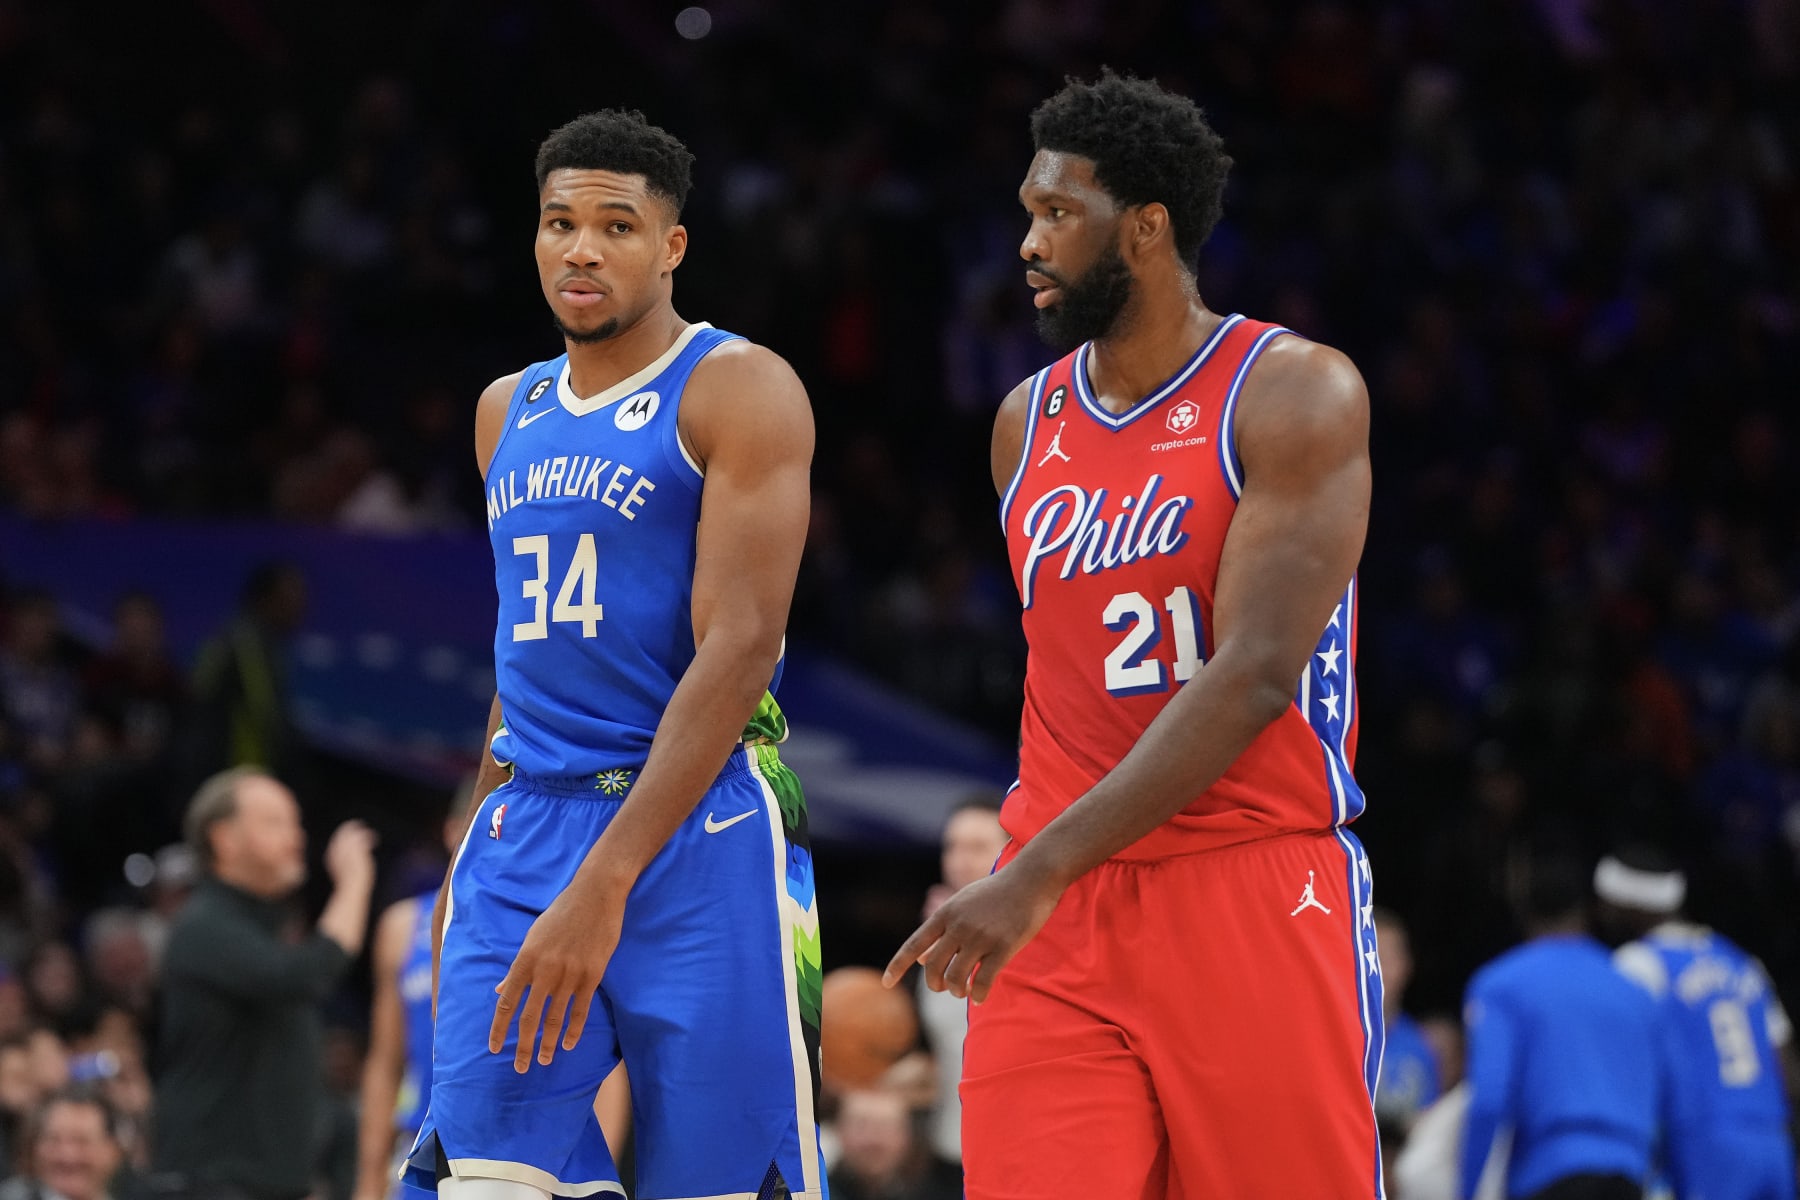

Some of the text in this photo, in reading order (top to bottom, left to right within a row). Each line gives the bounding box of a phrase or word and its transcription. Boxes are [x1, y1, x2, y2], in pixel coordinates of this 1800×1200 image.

[529, 380, 550, 401] 6
[1048, 389, 1064, 415] 6
[1151, 436, 1207, 451] crypto.com
[487, 455, 656, 532] MILWAUKEE
[1022, 473, 1192, 609] Phila
[512, 533, 604, 643] 34
[1102, 586, 1207, 694] 21
